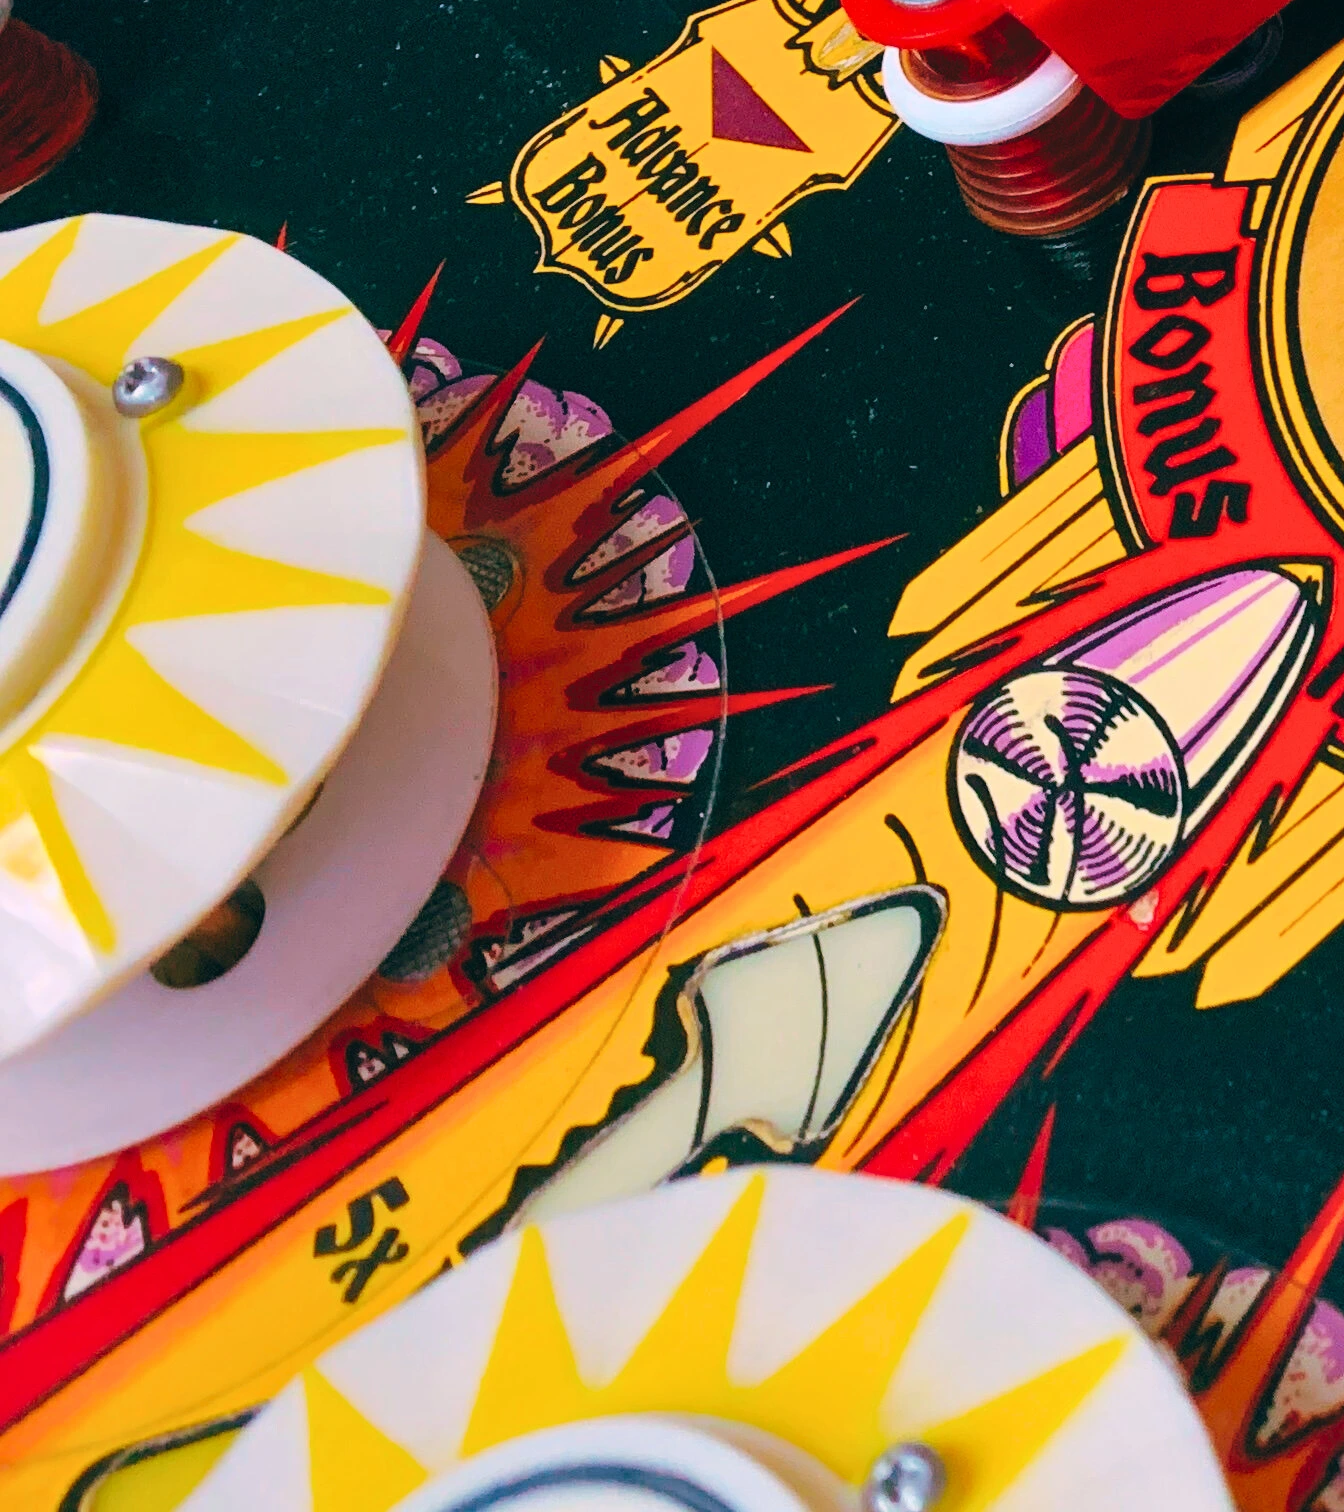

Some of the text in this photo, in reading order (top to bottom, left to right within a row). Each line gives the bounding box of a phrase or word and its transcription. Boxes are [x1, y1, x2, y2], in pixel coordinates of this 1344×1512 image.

[532, 152, 654, 285] Bonus
[588, 87, 746, 250] Advance
[1127, 245, 1252, 540] Bonus
